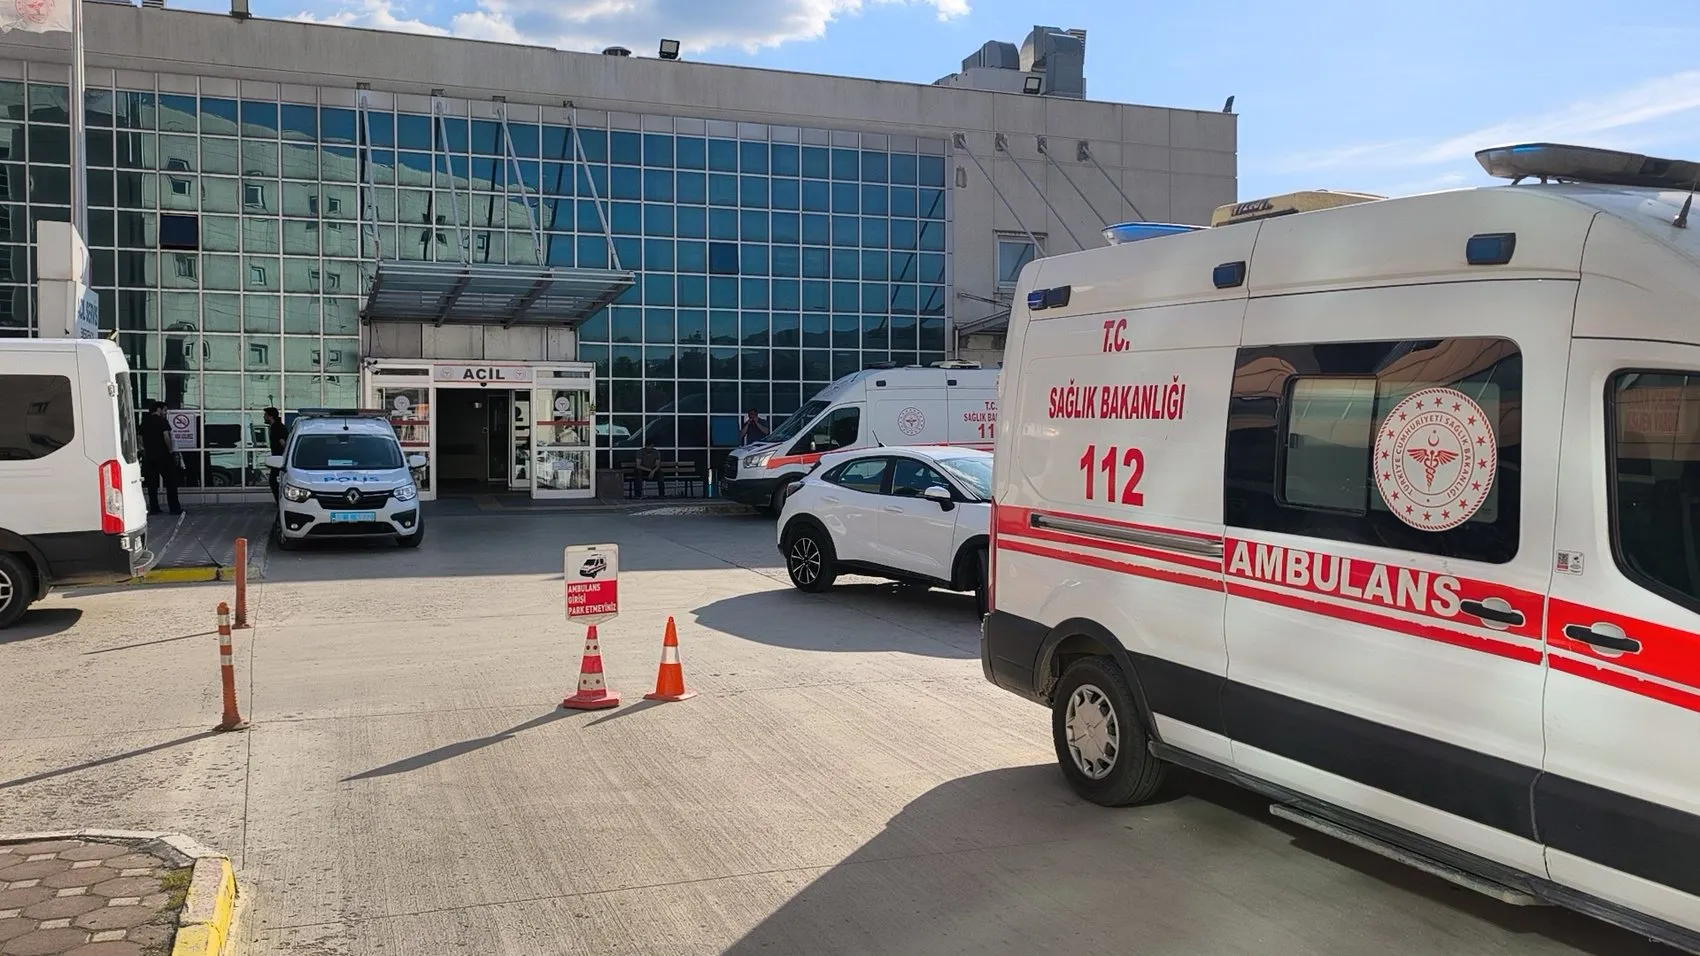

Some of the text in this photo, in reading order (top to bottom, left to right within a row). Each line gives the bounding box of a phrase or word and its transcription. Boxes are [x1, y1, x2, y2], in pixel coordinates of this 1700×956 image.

[1103, 319, 1130, 352] T.C.
[463, 367, 506, 380] ACİL
[1049, 375, 1186, 420] SAĞLIK BAKANLIĞI
[985, 402, 998, 411] T.C.
[988, 412, 998, 422] BA
[1080, 445, 1145, 507] 112
[1228, 540, 1462, 617] AMBULANS
[568, 584, 601, 593] AMBULANS
[568, 605, 585, 615] PARK
